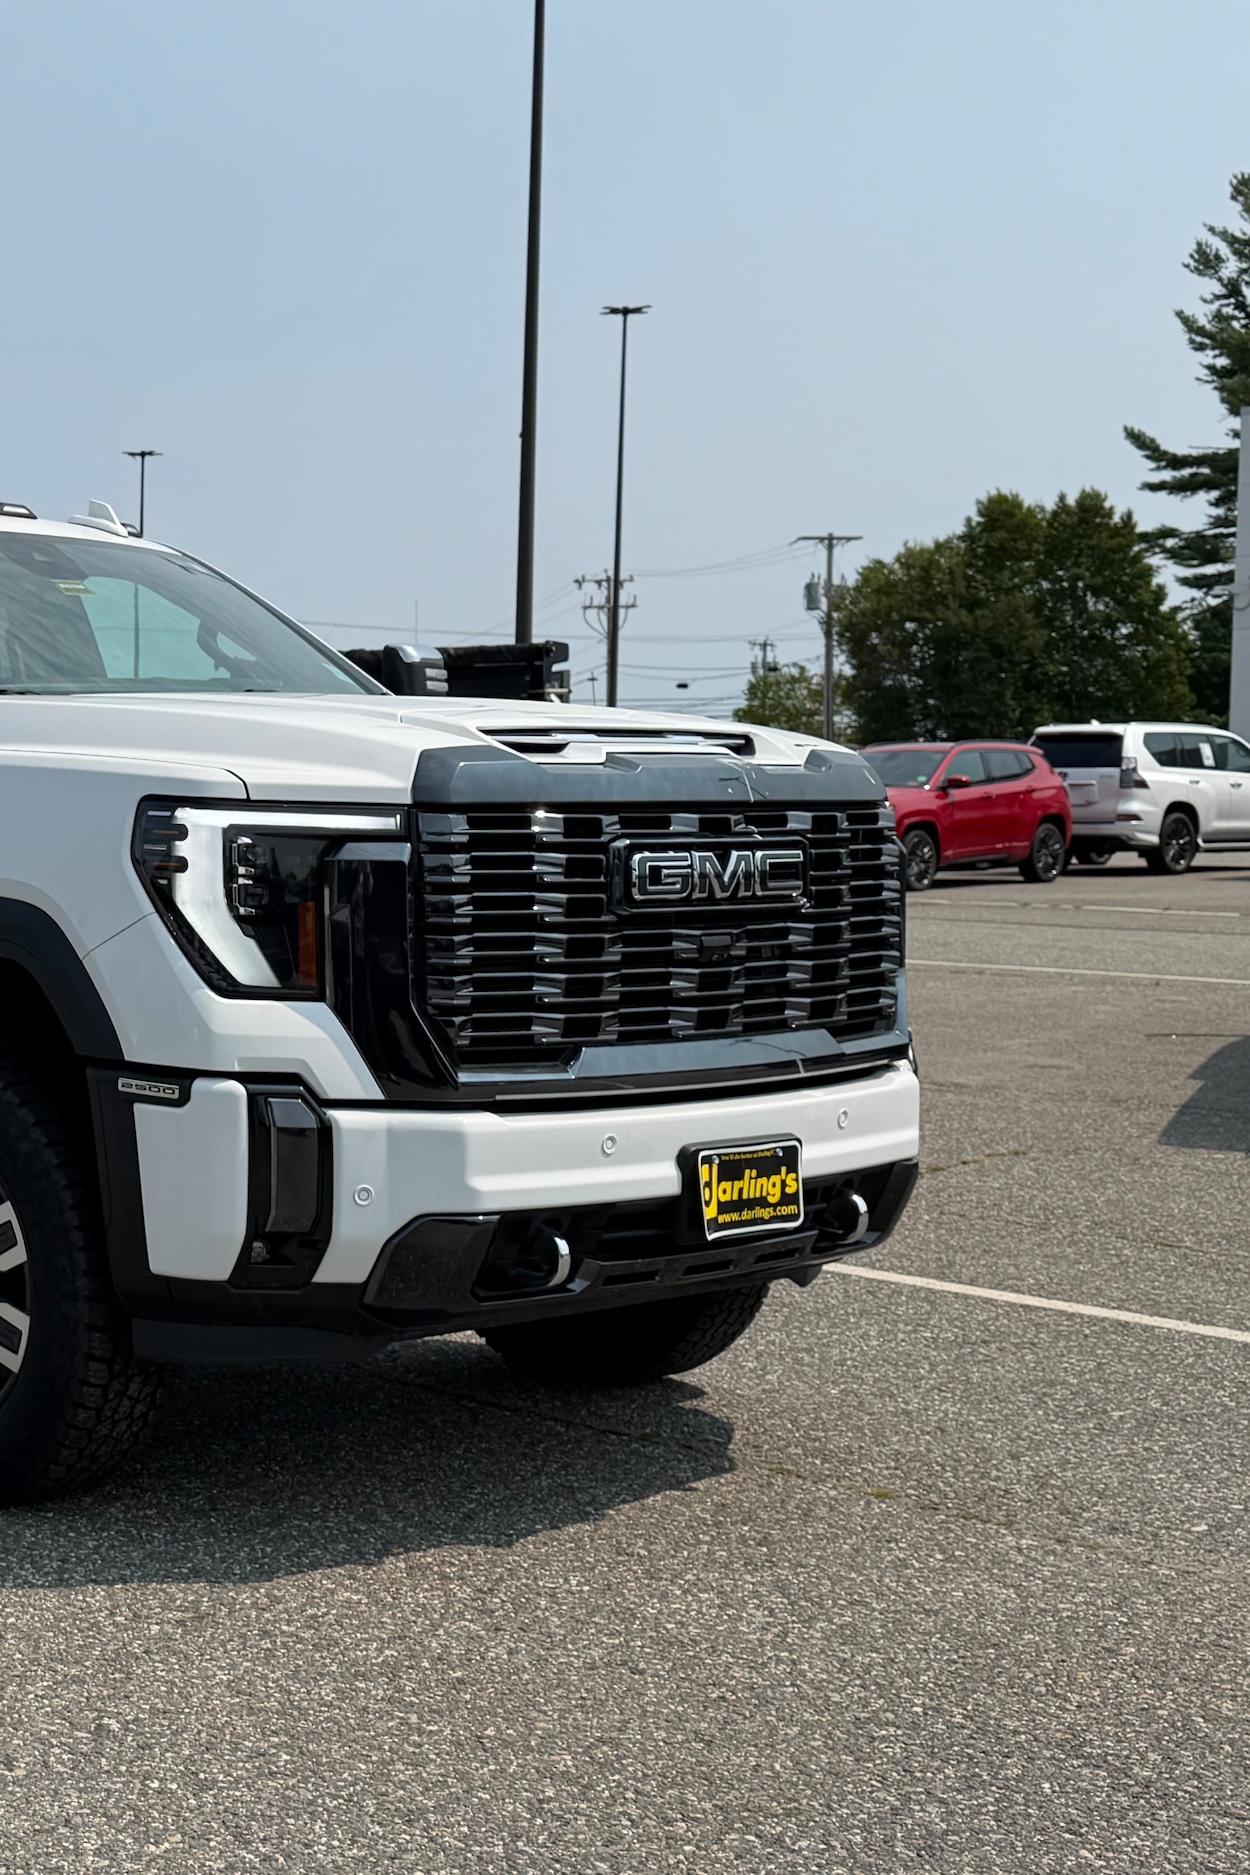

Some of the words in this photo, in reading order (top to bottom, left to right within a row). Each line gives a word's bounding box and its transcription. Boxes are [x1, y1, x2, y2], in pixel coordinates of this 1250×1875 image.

[631, 849, 804, 902] GMC
[121, 1081, 176, 1095] 2500
[701, 1163, 798, 1220] darling's
[717, 1204, 798, 1224] www.darlings.com
